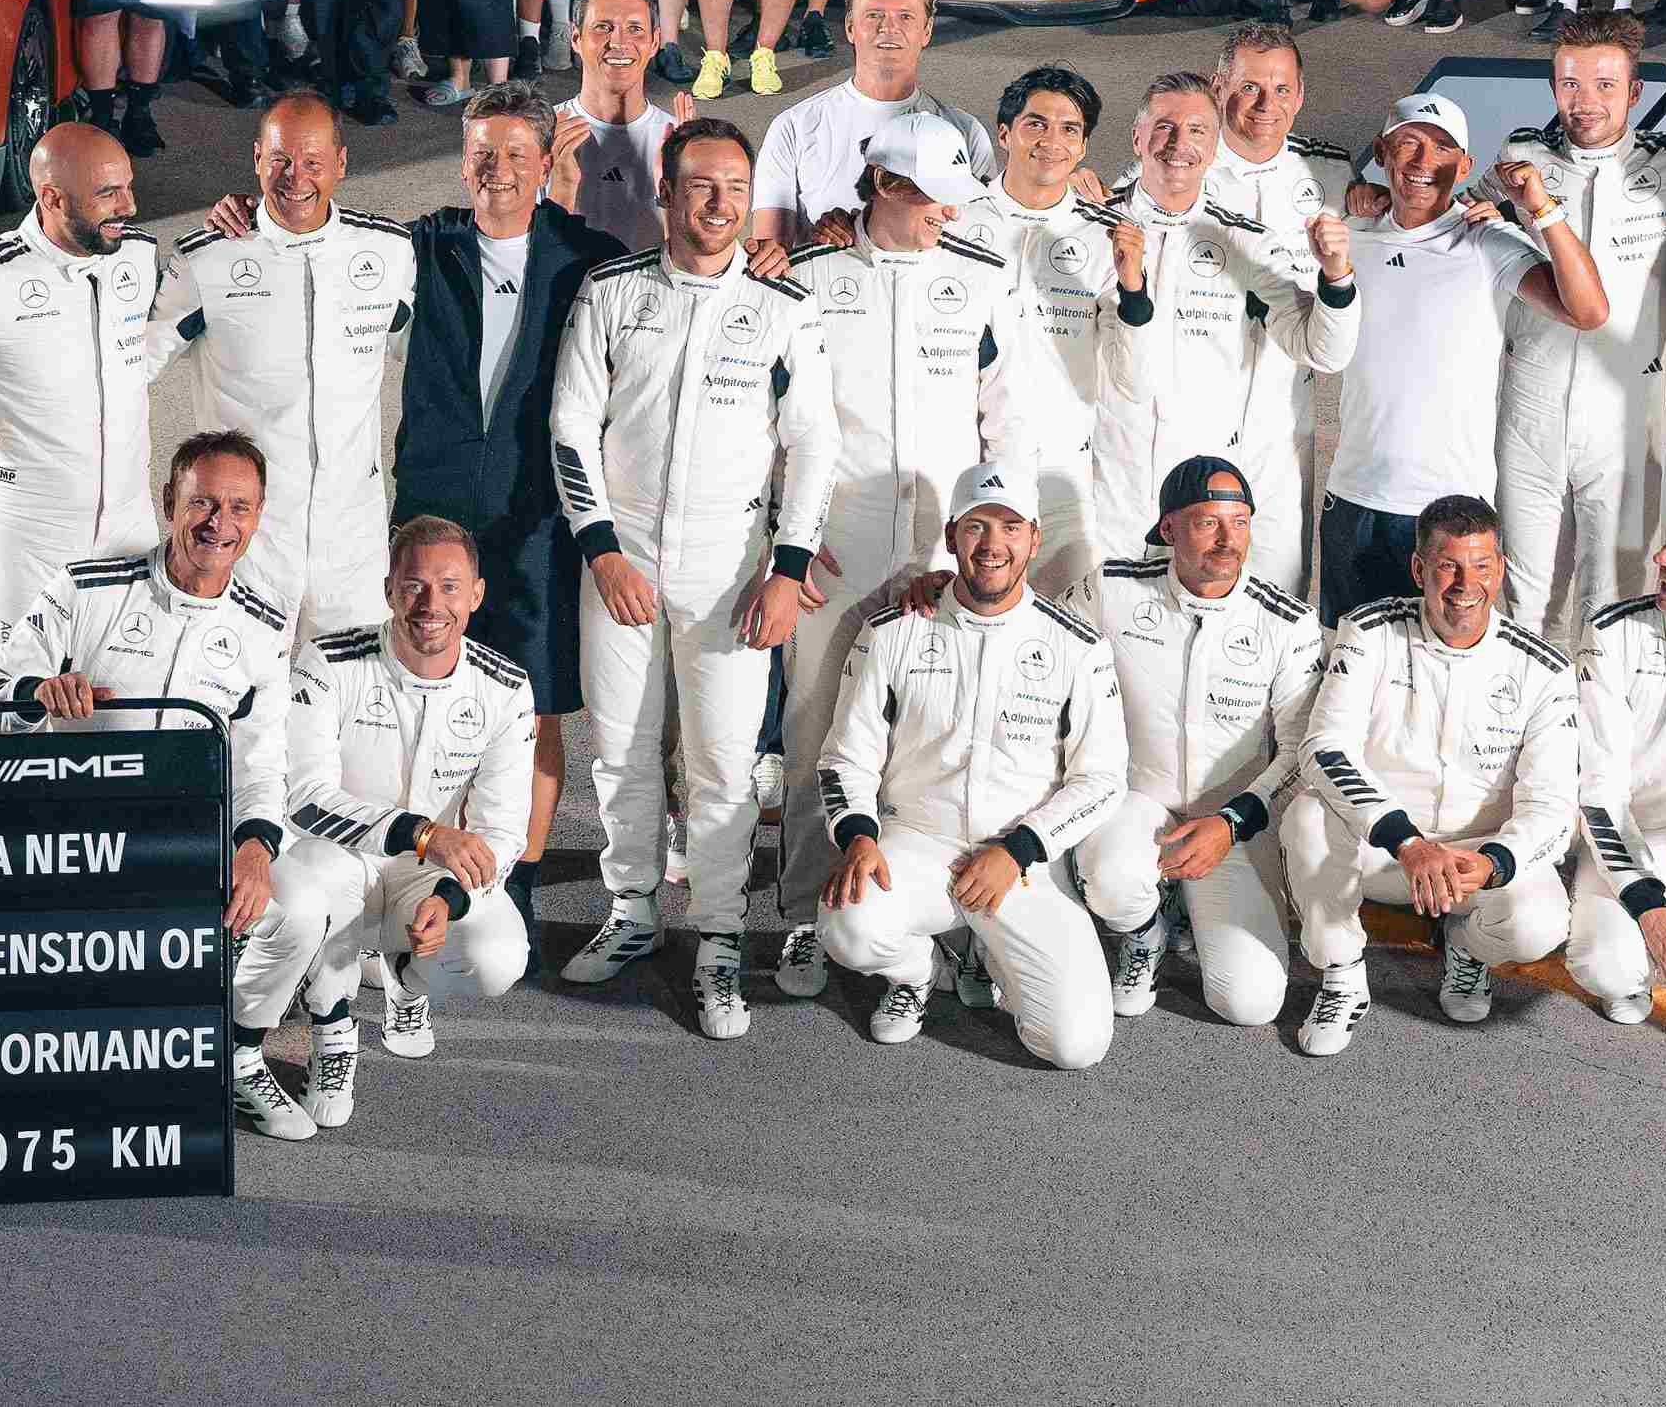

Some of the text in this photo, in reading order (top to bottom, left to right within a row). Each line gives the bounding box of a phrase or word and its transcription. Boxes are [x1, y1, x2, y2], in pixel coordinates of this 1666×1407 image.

[1617, 252, 1644, 263] YASA
[1046, 304, 1094, 321] alpitronic
[1185, 307, 1232, 322] alpitronic
[1043, 326, 1069, 336] YASA
[927, 367, 953, 376] YASA
[714, 375, 760, 390] alpitronic
[710, 396, 735, 406] YASA
[183, 719, 208, 732] YASA
[1006, 731, 1032, 742] YASA
[11, 753, 145, 782] AMG
[25, 831, 126, 875] NEW
[160, 927, 215, 971] OF
[111, 1124, 183, 1169] KM
